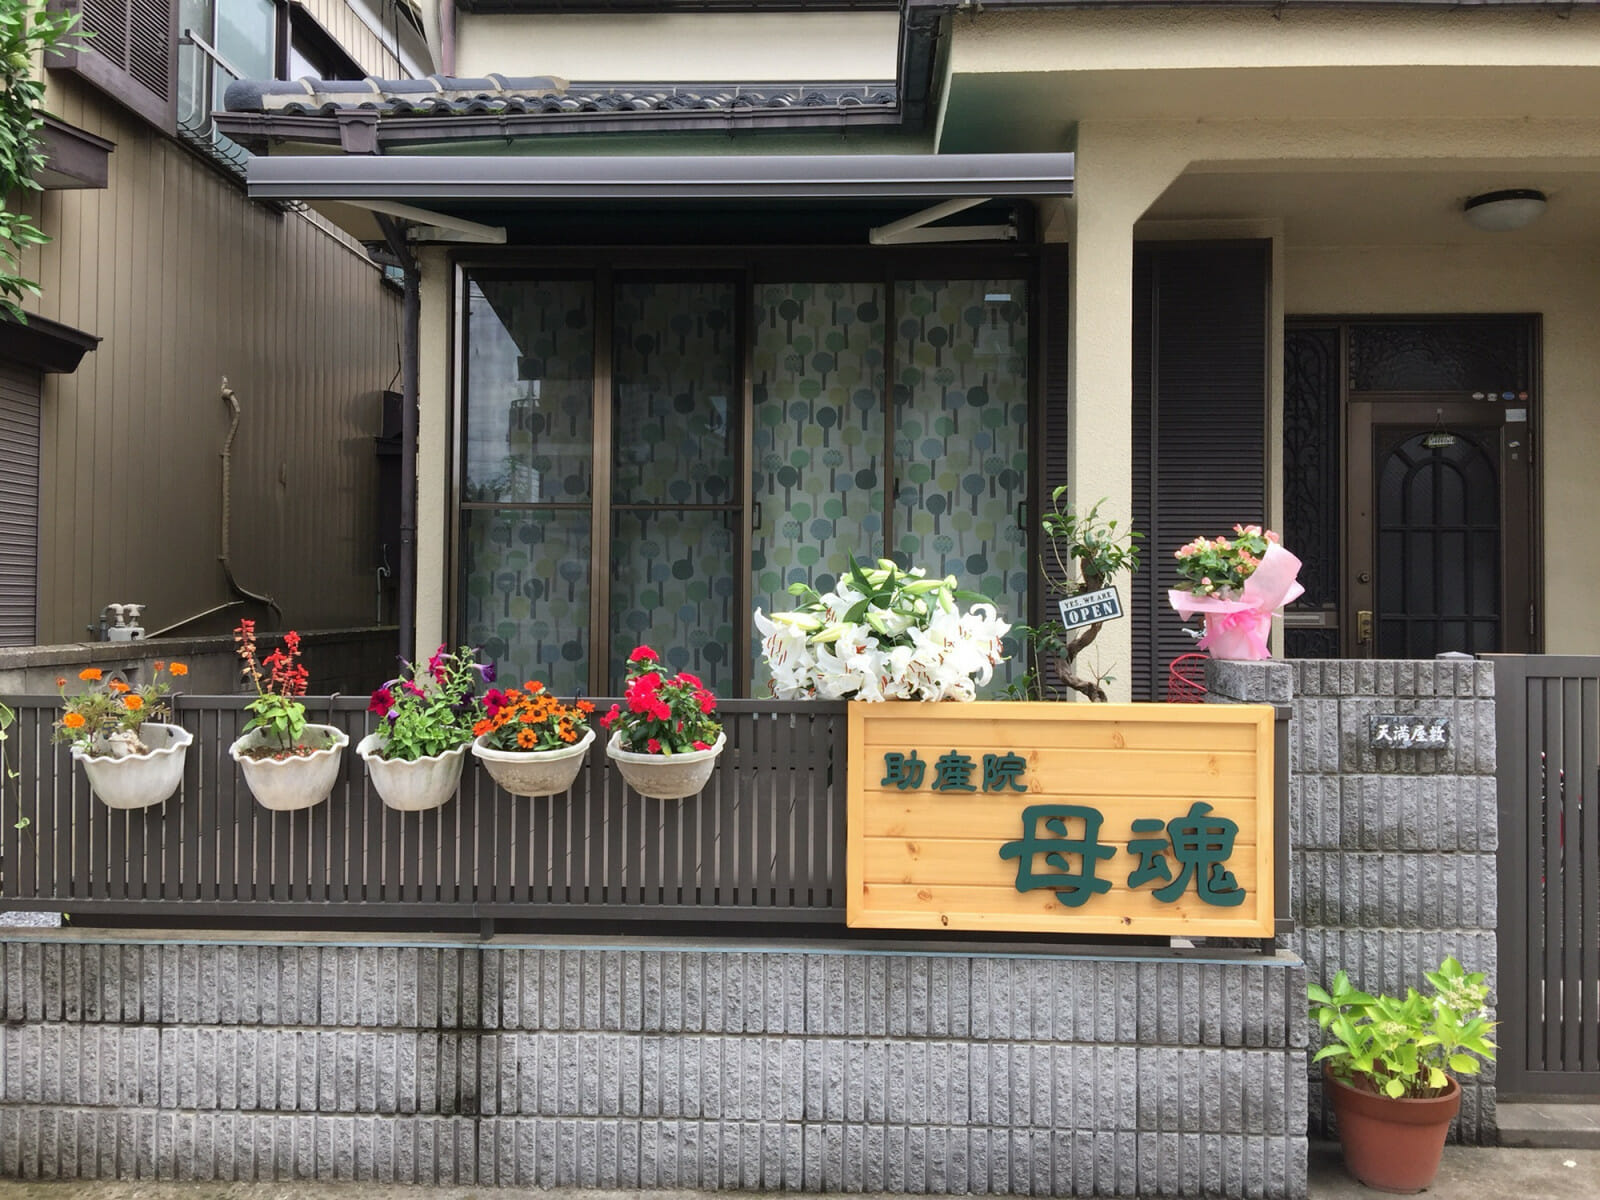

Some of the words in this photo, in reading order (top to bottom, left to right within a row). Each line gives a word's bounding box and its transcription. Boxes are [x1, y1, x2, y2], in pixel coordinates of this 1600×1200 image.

[1069, 601, 1113, 623] OPEN
[1083, 596, 1095, 604] WE
[1097, 591, 1112, 600] ARE
[881, 750, 1028, 792] 助産院
[999, 801, 1247, 907] 母魂
